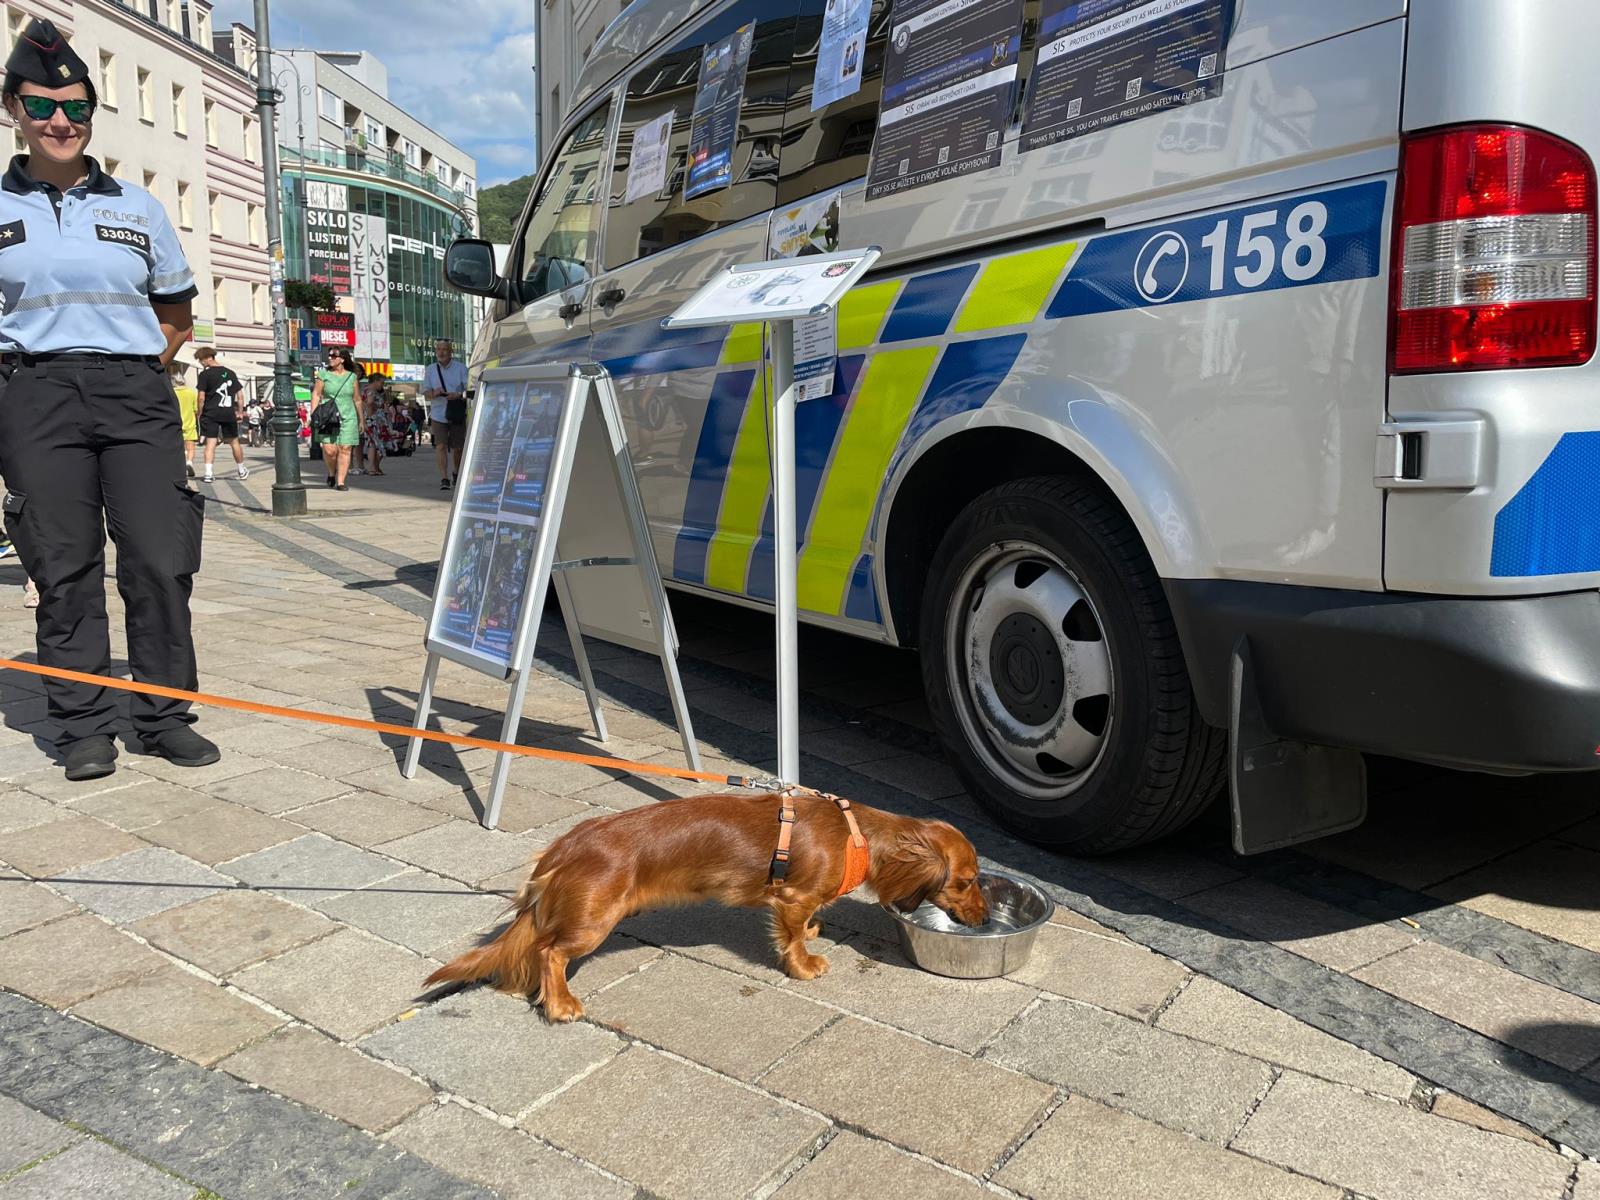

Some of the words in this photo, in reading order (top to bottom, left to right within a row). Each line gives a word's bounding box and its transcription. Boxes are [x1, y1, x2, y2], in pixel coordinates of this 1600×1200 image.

[1052, 40, 1066, 55] SIS
[1069, 30, 1096, 47] PROTECTS
[1097, 24, 1112, 36] YOUR
[1112, 13, 1139, 29] SECURITY
[1139, 11, 1146, 19] AS
[1147, 5, 1163, 16] WELL
[1164, 1, 1172, 11] AS
[904, 103, 915, 116] SIS
[1030, 135, 1048, 145] THANKS
[1048, 132, 1056, 140] TO
[1056, 129, 1065, 138] THE
[1076, 123, 1088, 131] YOU
[1088, 118, 1099, 128] CAN
[1100, 112, 1119, 124] TRAVEL
[1120, 107, 1140, 118] FREELY
[1140, 102, 1152, 112] AND
[1152, 95, 1173, 108] SAFELY
[1173, 93, 1181, 102] IN
[1181, 86, 1207, 100] EUROPE
[890, 182, 897, 190] SE
[959, 155, 991, 171] POHYBOVAT
[92, 208, 150, 227] POLICE
[307, 210, 347, 229] SKLO
[100, 228, 146, 246] 330343
[309, 231, 348, 246] LUSTRY
[1201, 201, 1328, 291] 158
[309, 249, 349, 261] PORCELAN
[350, 214, 367, 290] SVĚT
[388, 281, 434, 297] OBCHODNÍ
[317, 313, 349, 323] REPLAY
[320, 330, 348, 342] DIESEL
